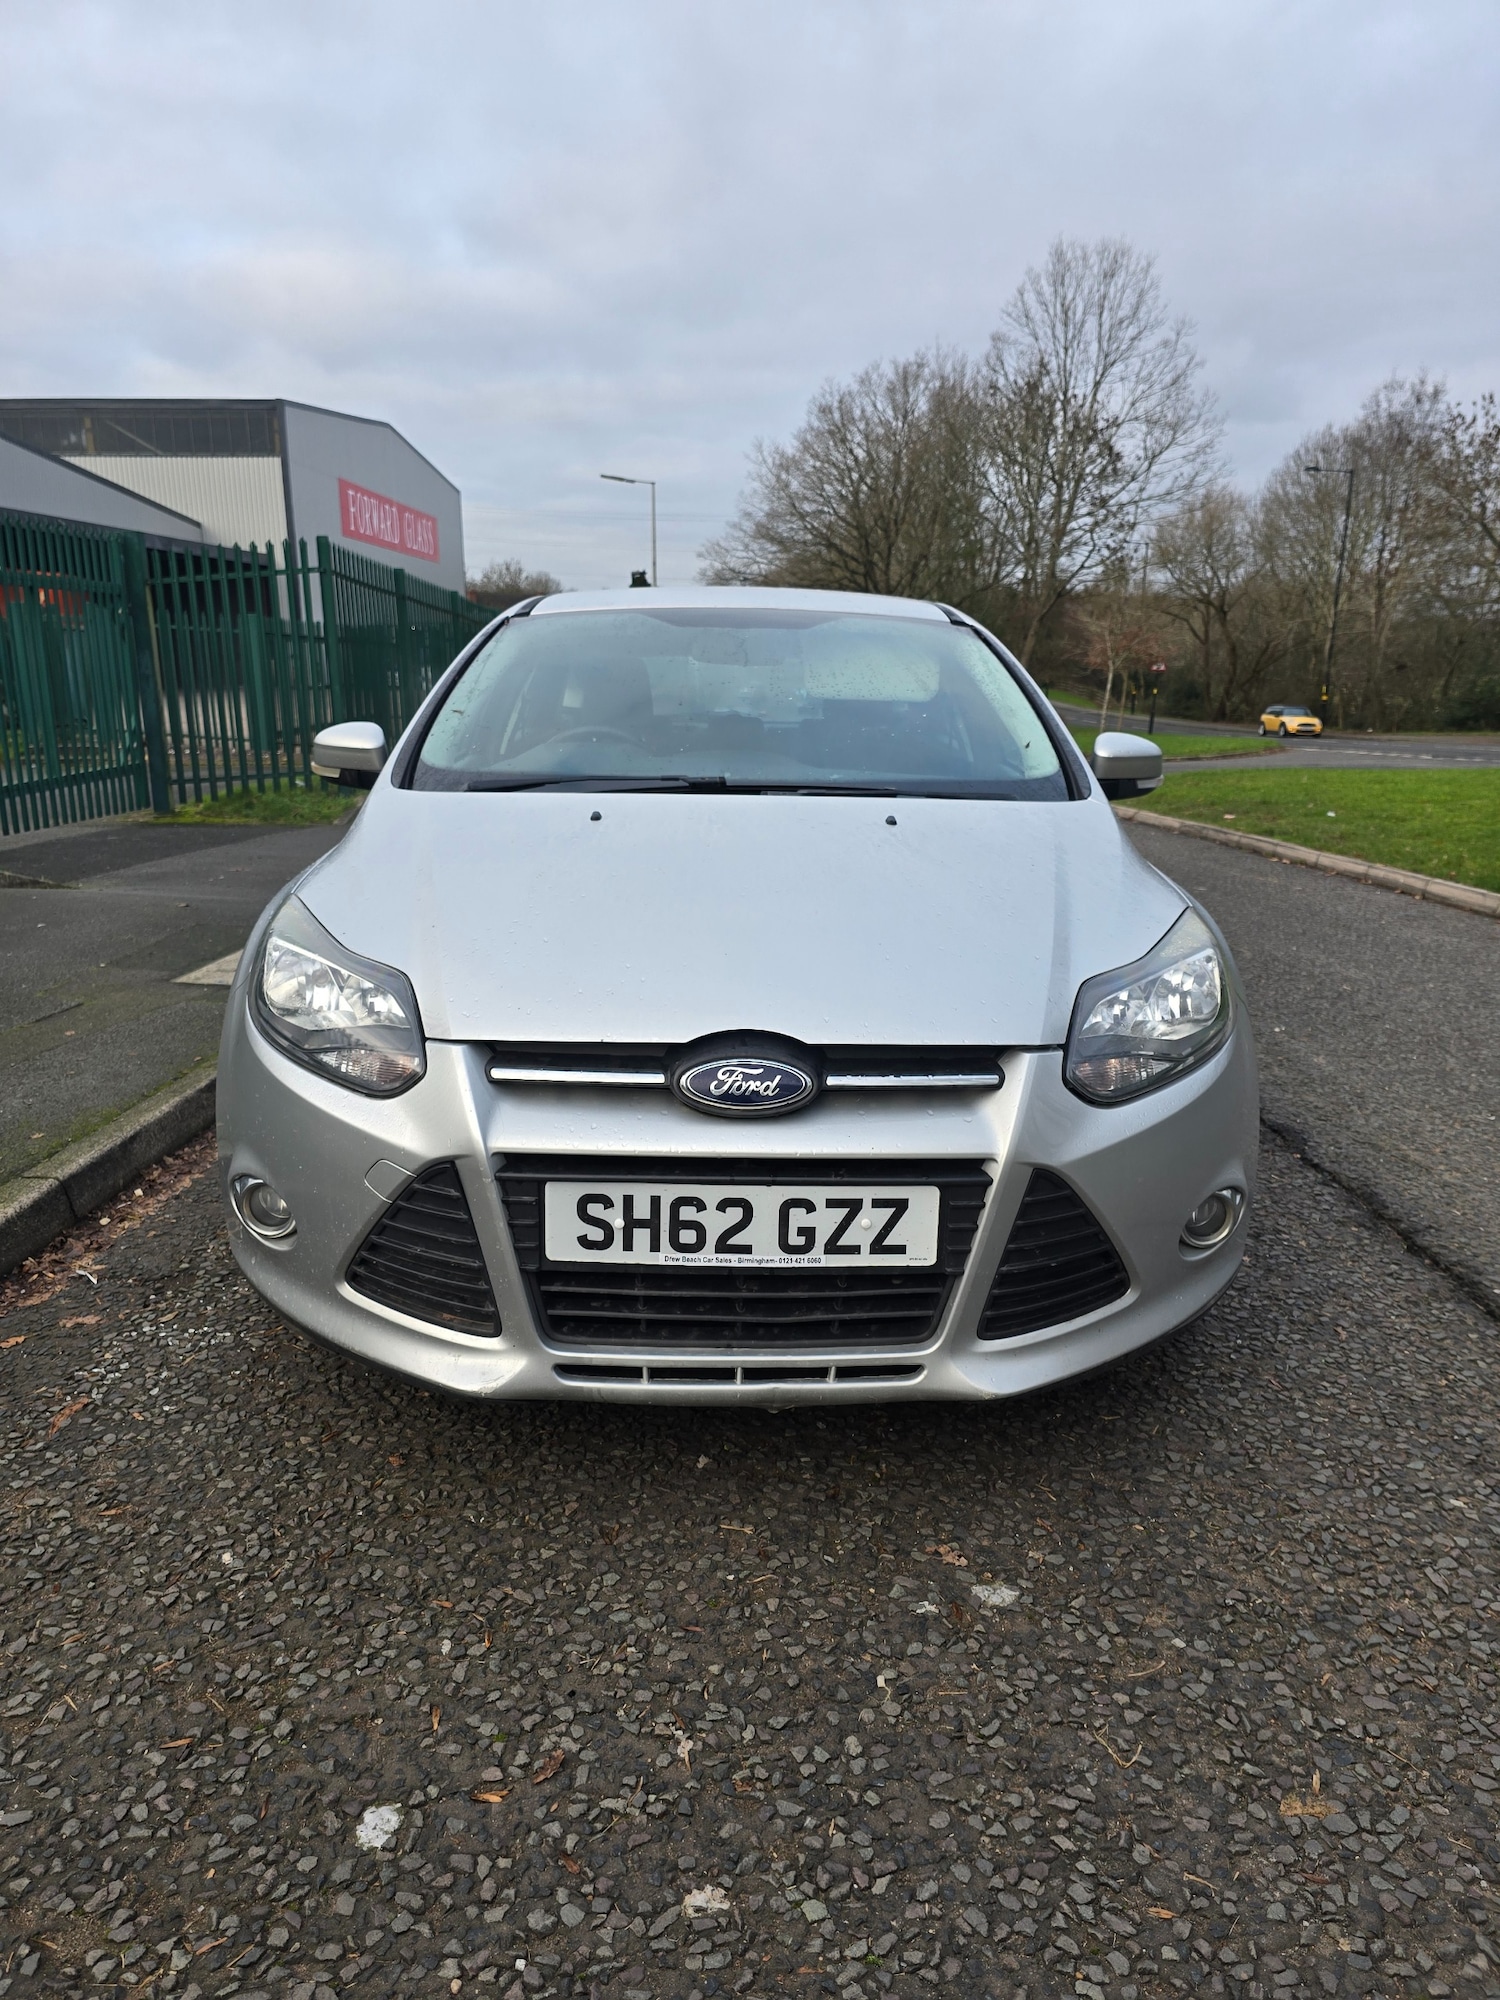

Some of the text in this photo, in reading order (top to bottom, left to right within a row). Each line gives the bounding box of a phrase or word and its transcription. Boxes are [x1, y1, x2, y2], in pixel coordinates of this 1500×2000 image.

[347, 489, 434, 555] FORWARD GLASS
[709, 1066, 782, 1096] Ford
[576, 1193, 909, 1255] SH62 GZZ
[664, 1255, 681, 1263] Drew
